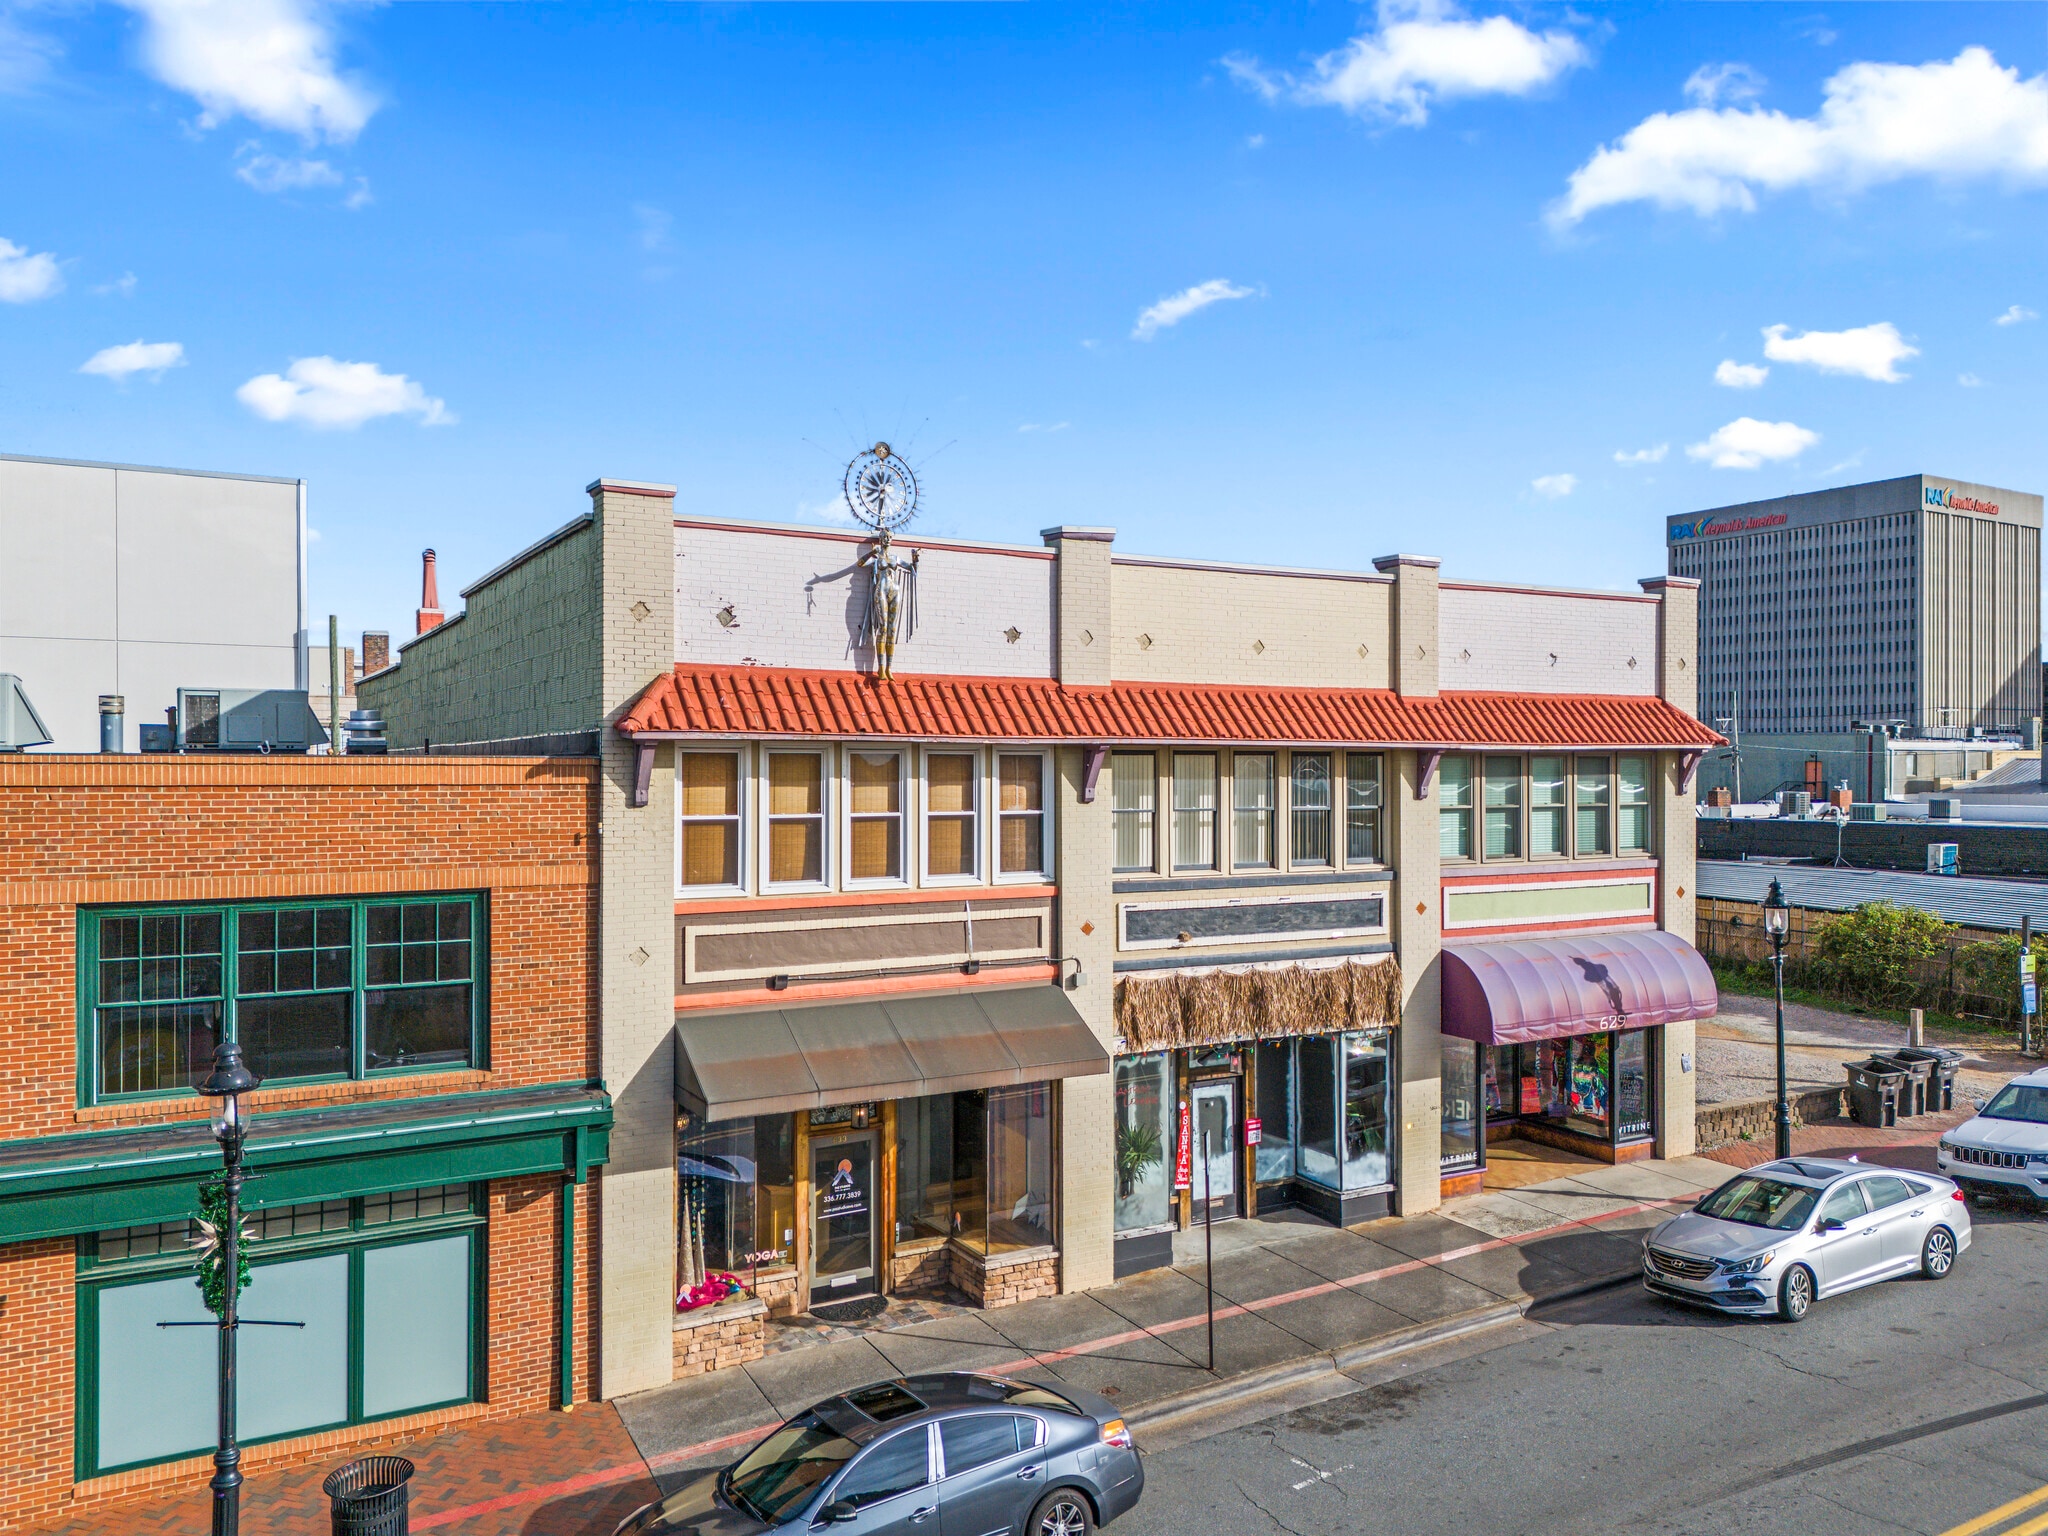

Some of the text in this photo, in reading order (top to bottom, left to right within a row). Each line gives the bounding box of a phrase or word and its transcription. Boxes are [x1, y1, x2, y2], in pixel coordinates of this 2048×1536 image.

[1671, 513, 1787, 540] RAI Reynolds American
[1600, 1015, 1626, 1030] 629
[1619, 1121, 1651, 1135] VITRINE
[1180, 1115, 1189, 1165] SANTA
[1440, 1151, 1477, 1166] VITRINE
[823, 1190, 861, 1203] 336.777.3839
[744, 1249, 778, 1264] YOGA
